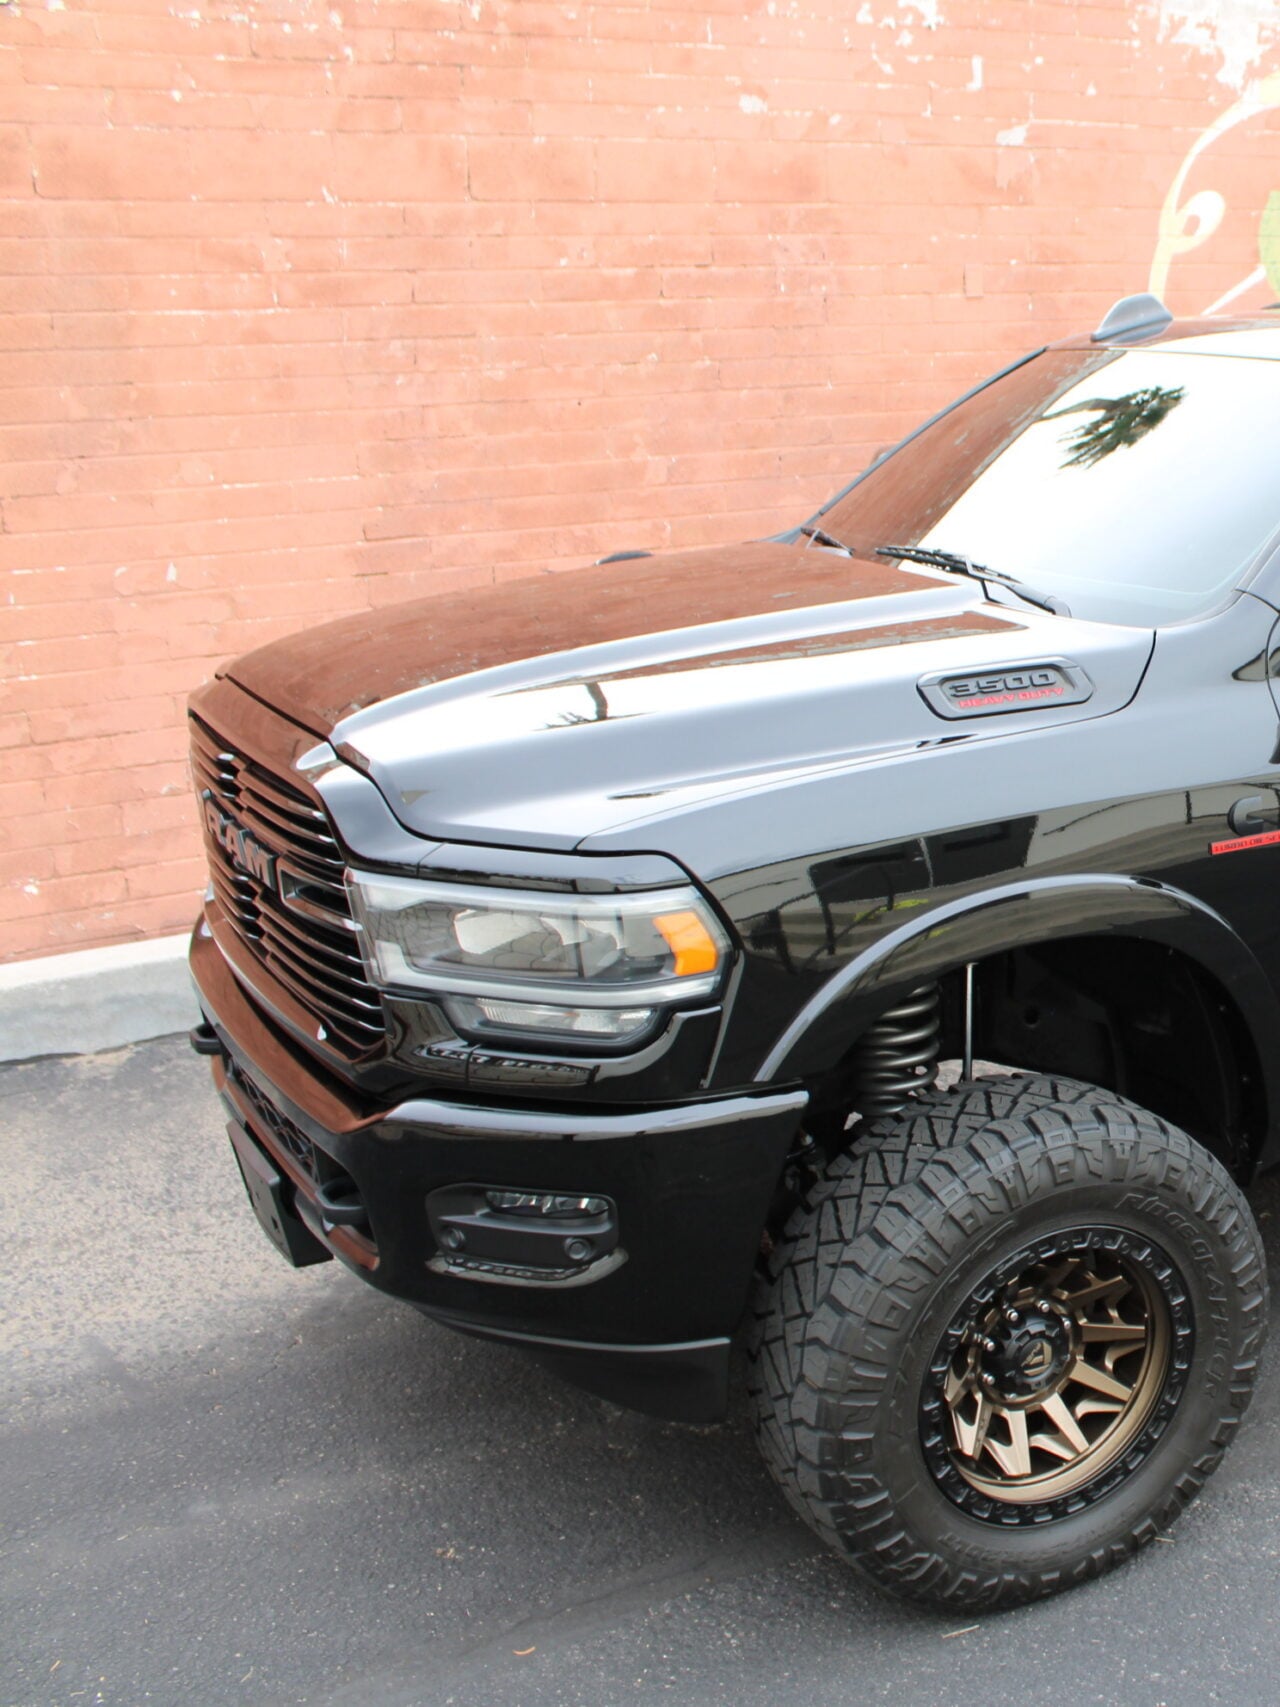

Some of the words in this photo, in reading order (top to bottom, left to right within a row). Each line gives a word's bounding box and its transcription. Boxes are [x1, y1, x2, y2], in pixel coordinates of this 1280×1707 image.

[949, 672, 1058, 698] 3500
[959, 693, 1015, 709] HEAVY
[1017, 687, 1065, 701] DUTY
[203, 797, 281, 893] RAM
